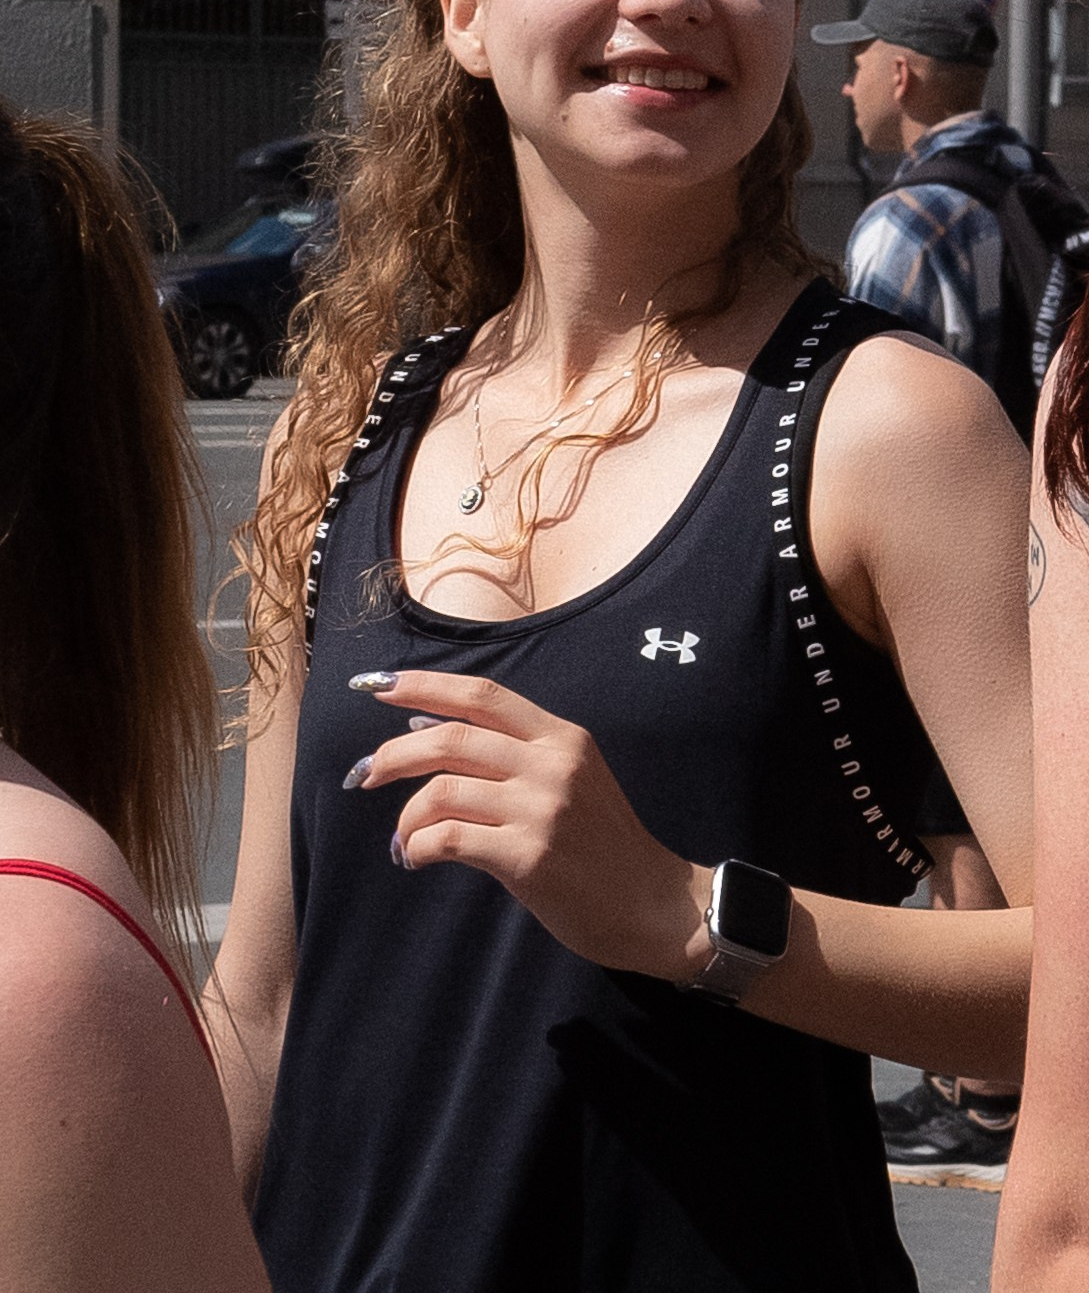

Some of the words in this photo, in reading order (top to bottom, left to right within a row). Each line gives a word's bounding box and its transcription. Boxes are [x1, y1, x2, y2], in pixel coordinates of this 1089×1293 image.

[354, 353, 421, 449] UNDER
[771, 412, 798, 558] ARMOUR
[789, 585, 840, 713] UNDER
